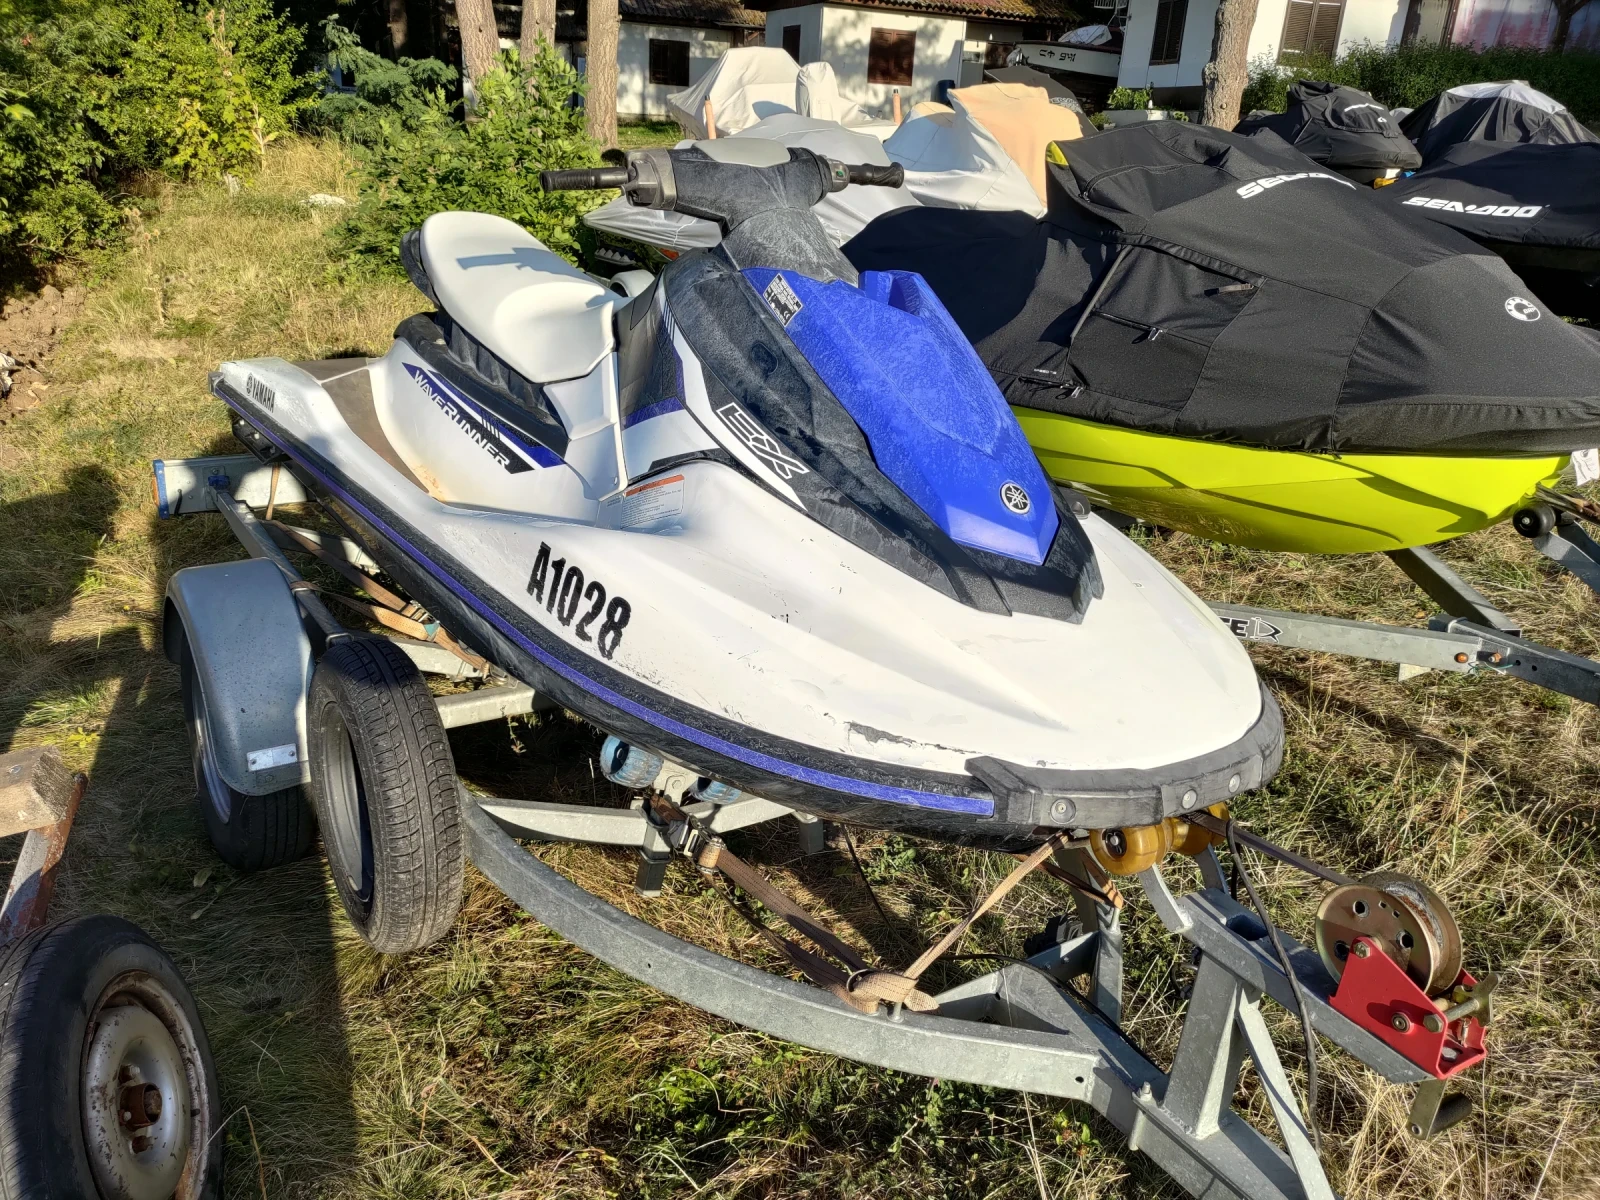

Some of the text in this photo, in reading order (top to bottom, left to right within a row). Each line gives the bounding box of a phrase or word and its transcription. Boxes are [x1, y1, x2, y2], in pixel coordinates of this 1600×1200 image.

[252, 377, 276, 414] YAMAHA
[716, 402, 810, 479] EX
[526, 540, 632, 661] A1028
